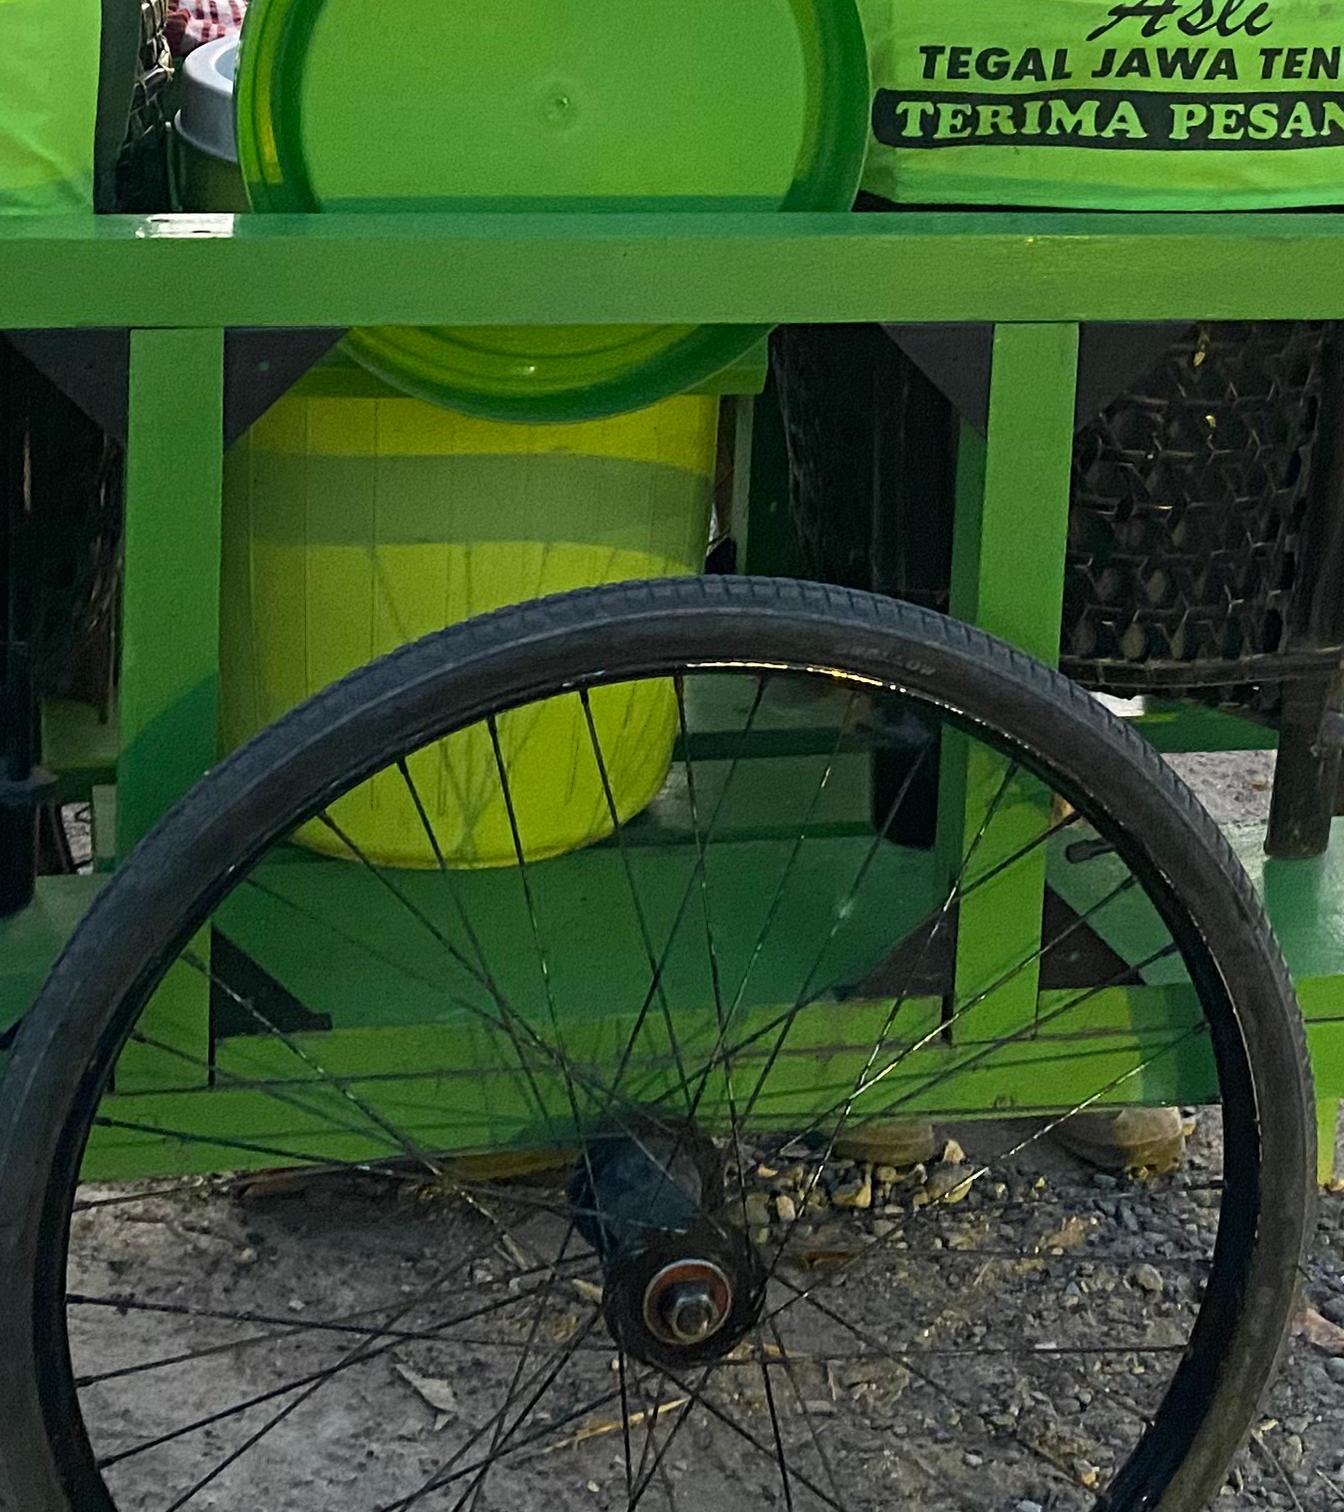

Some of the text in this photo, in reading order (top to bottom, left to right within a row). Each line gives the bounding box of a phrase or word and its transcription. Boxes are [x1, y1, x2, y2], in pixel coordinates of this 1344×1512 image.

[918, 44, 1073, 82] TEGAL
[1090, 46, 1239, 81] JAWA
[895, 98, 1149, 140] TERIMA
